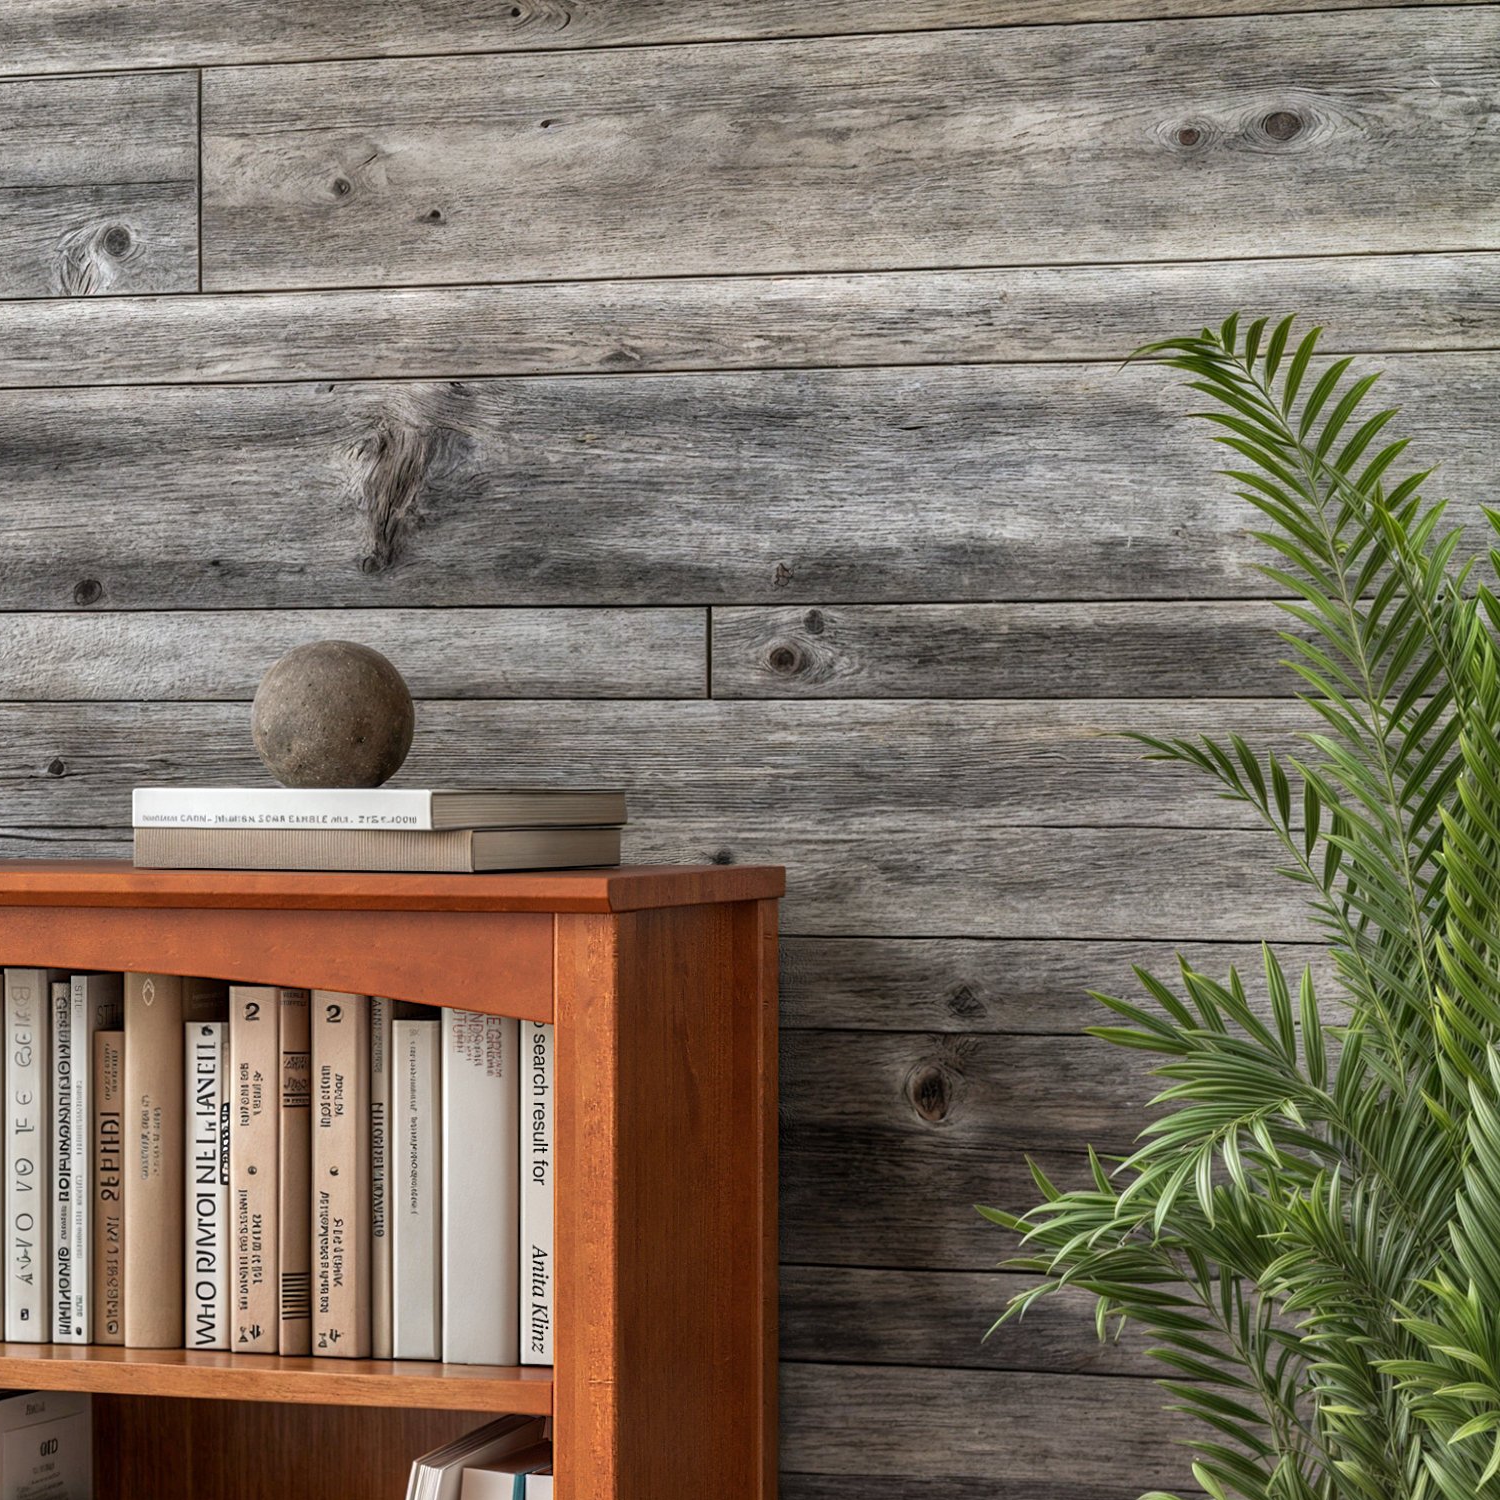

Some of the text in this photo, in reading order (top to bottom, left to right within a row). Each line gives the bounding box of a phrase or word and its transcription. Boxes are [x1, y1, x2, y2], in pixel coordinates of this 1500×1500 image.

[245, 1002, 260, 1022] 2
[325, 1004, 341, 1023] 2
[533, 1034, 549, 1186] search result for
[196, 1280, 217, 1346] WHO
[531, 1245, 549, 1354] Anita Klinz
